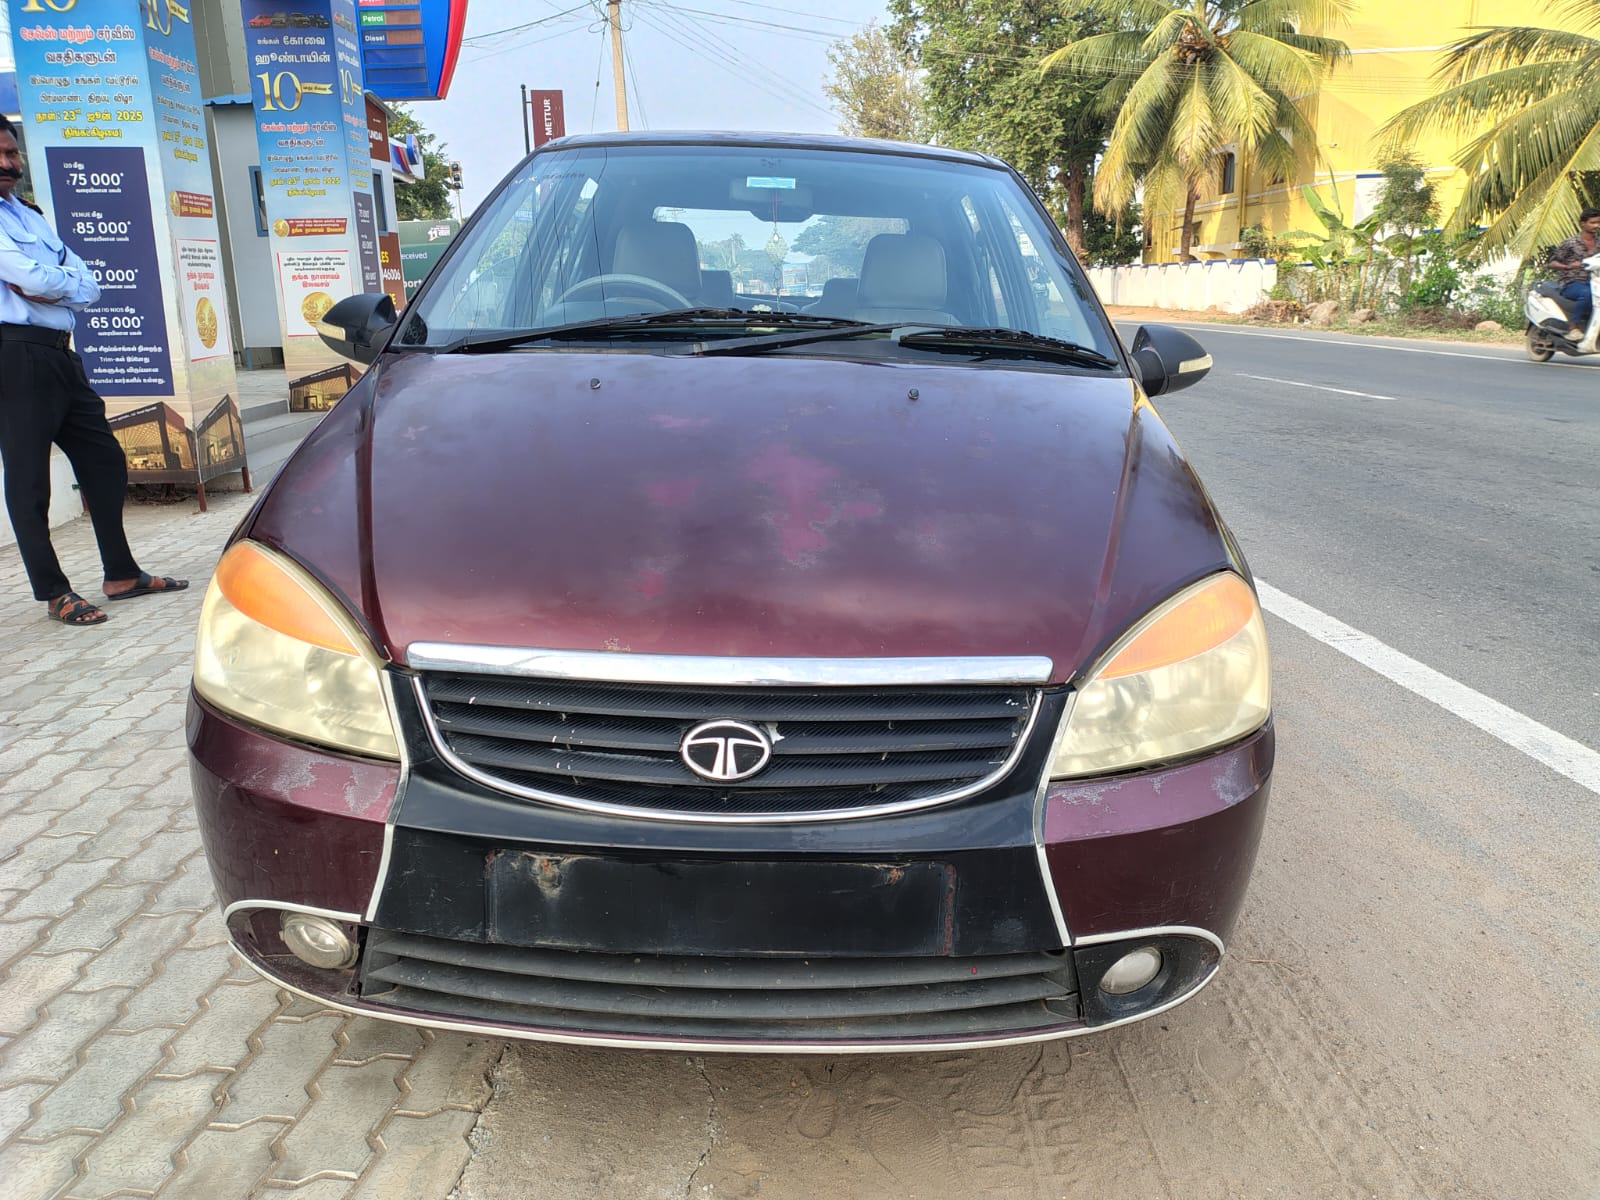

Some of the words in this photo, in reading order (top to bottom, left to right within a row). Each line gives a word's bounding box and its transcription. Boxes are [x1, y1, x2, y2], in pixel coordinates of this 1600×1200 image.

[20, 24, 58, 40] சேல்ஸ்
[59, 25, 94, 43] மற்றும்
[96, 24, 136, 43] சர்வீஸ்
[282, 36, 326, 46] கோவை
[45, 48, 116, 65] வசதிகளுடன்
[255, 50, 330, 65] ஹூண்டாயின்
[256, 72, 302, 111] 10
[117, 111, 143, 121] 2025
[544, 99, 552, 136] METTUR
[380, 251, 389, 263] ES
